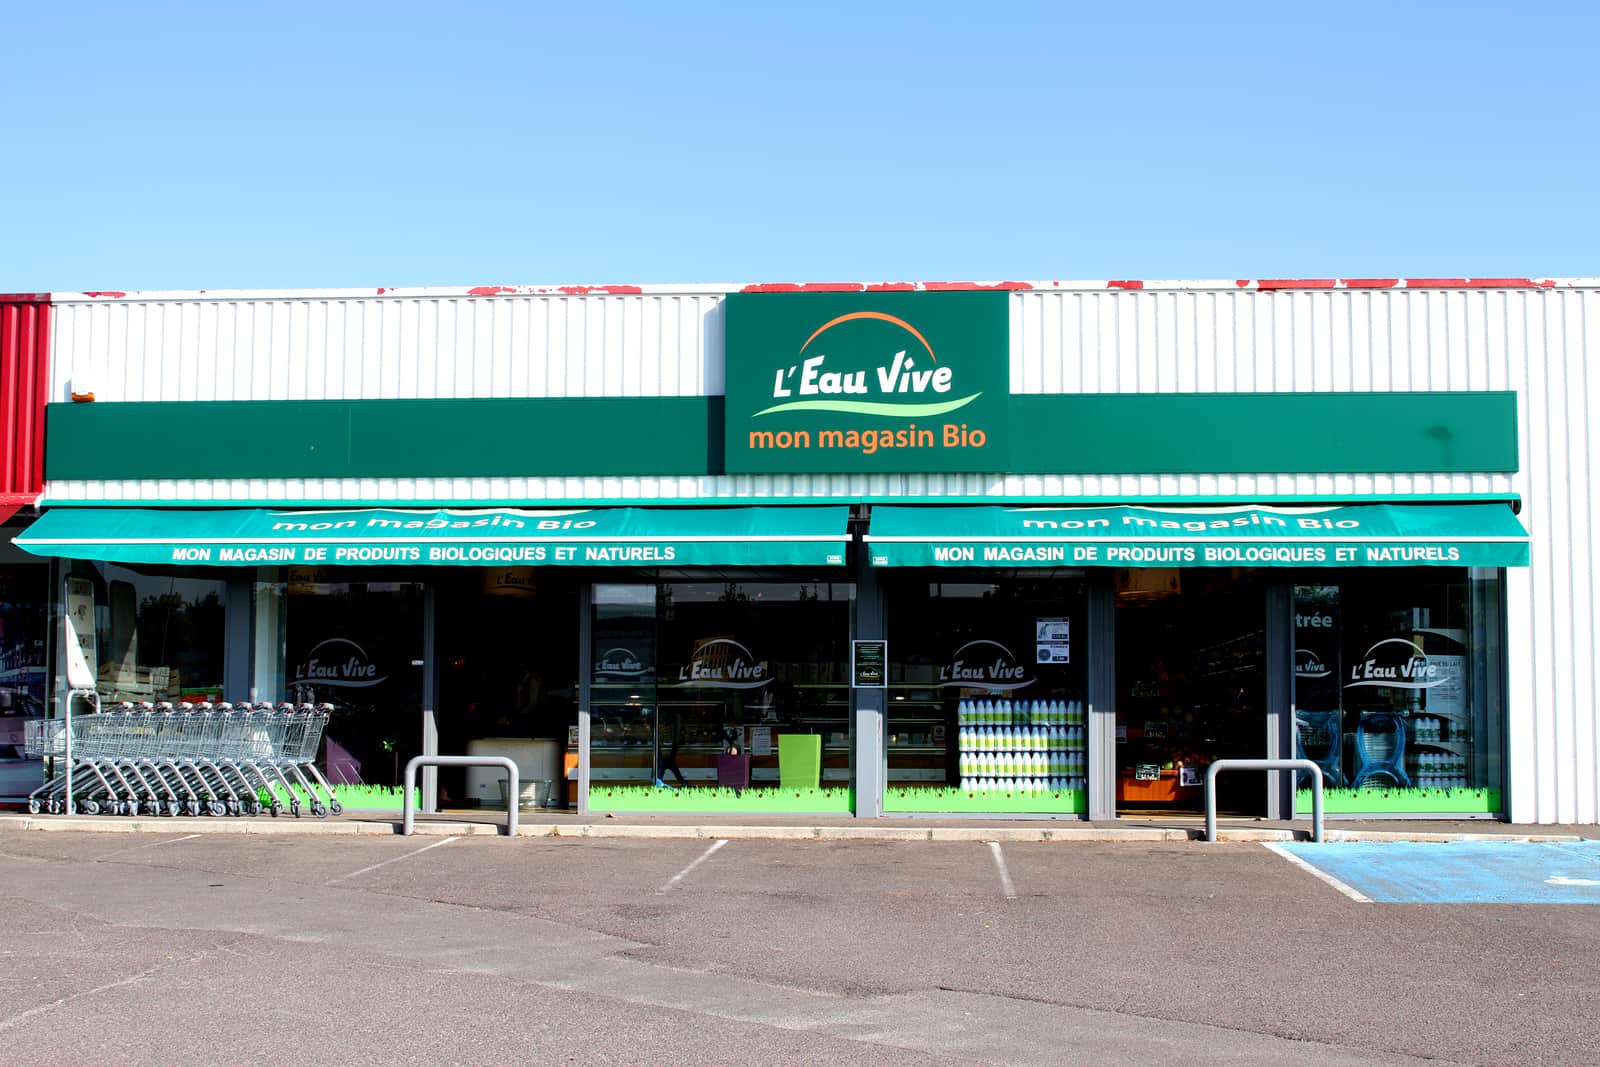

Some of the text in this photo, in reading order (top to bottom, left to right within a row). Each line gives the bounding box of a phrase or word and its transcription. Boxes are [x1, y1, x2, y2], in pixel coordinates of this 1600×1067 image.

[773, 350, 953, 398] L'Eau Vive
[749, 423, 986, 454] mon magasin Bio
[272, 515, 597, 531] mon magasin Bio
[1023, 512, 1360, 532] mon magasin Bio
[172, 546, 675, 562] MON MAGASIN DE PRODUITS BIOLOGIQUES ET NATURELS
[934, 546, 1460, 563] MON MAGASIN DE PRODUITS BIOLOGIQUES ET NATURELS
[1295, 611, 1333, 628] trée
[296, 655, 376, 679] L'Eau Vive
[679, 655, 763, 682] L'Eau Vive
[939, 657, 1025, 681] L'Eau Vive
[1304, 659, 1326, 672] Vive
[1351, 659, 1397, 680] L'Eau
[1400, 656, 1437, 678] Vive
